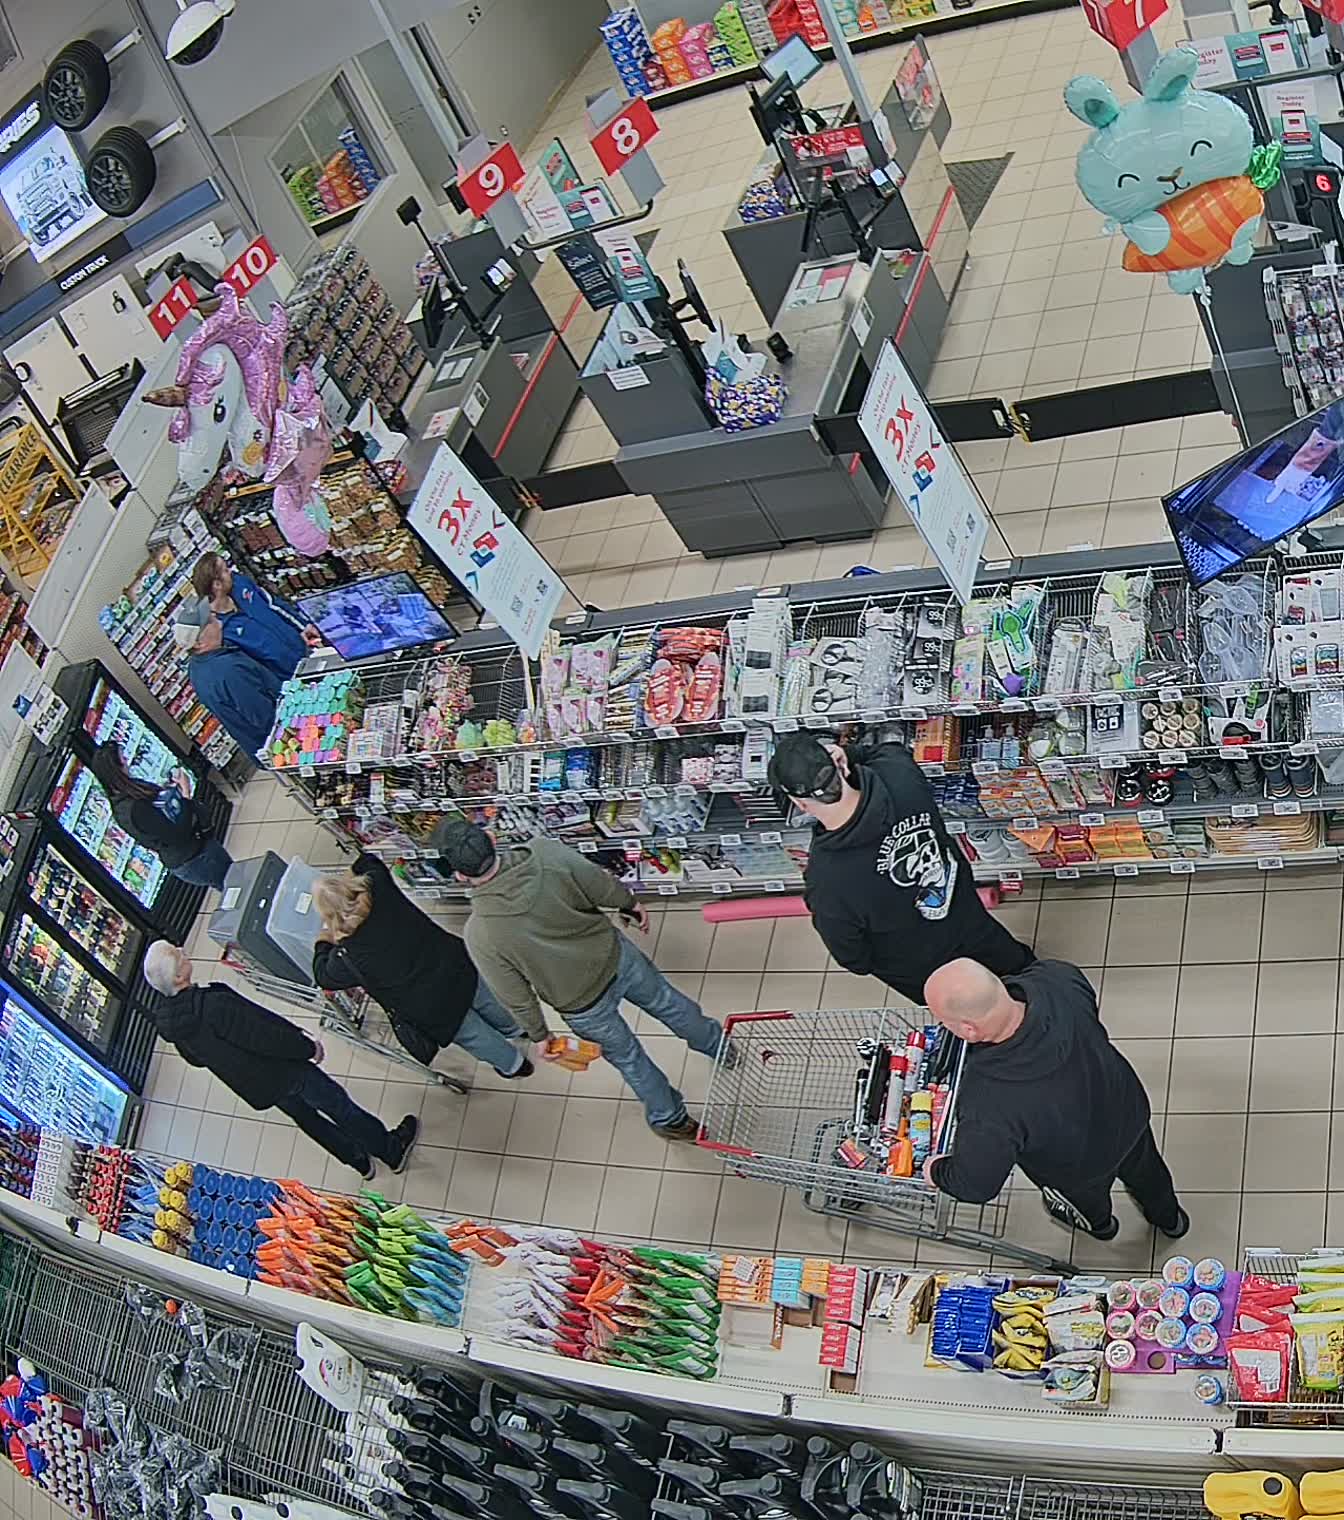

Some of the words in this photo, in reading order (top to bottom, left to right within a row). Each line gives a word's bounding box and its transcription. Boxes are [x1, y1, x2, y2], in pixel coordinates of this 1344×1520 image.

[611, 116, 641, 155] 8
[479, 163, 505, 197] 9
[1316, 174, 1333, 193] 6
[231, 246, 268, 288] 10
[158, 286, 191, 326] 11
[884, 393, 915, 462] 3X
[437, 487, 474, 546] 3X
[877, 836, 896, 873] BLUE
